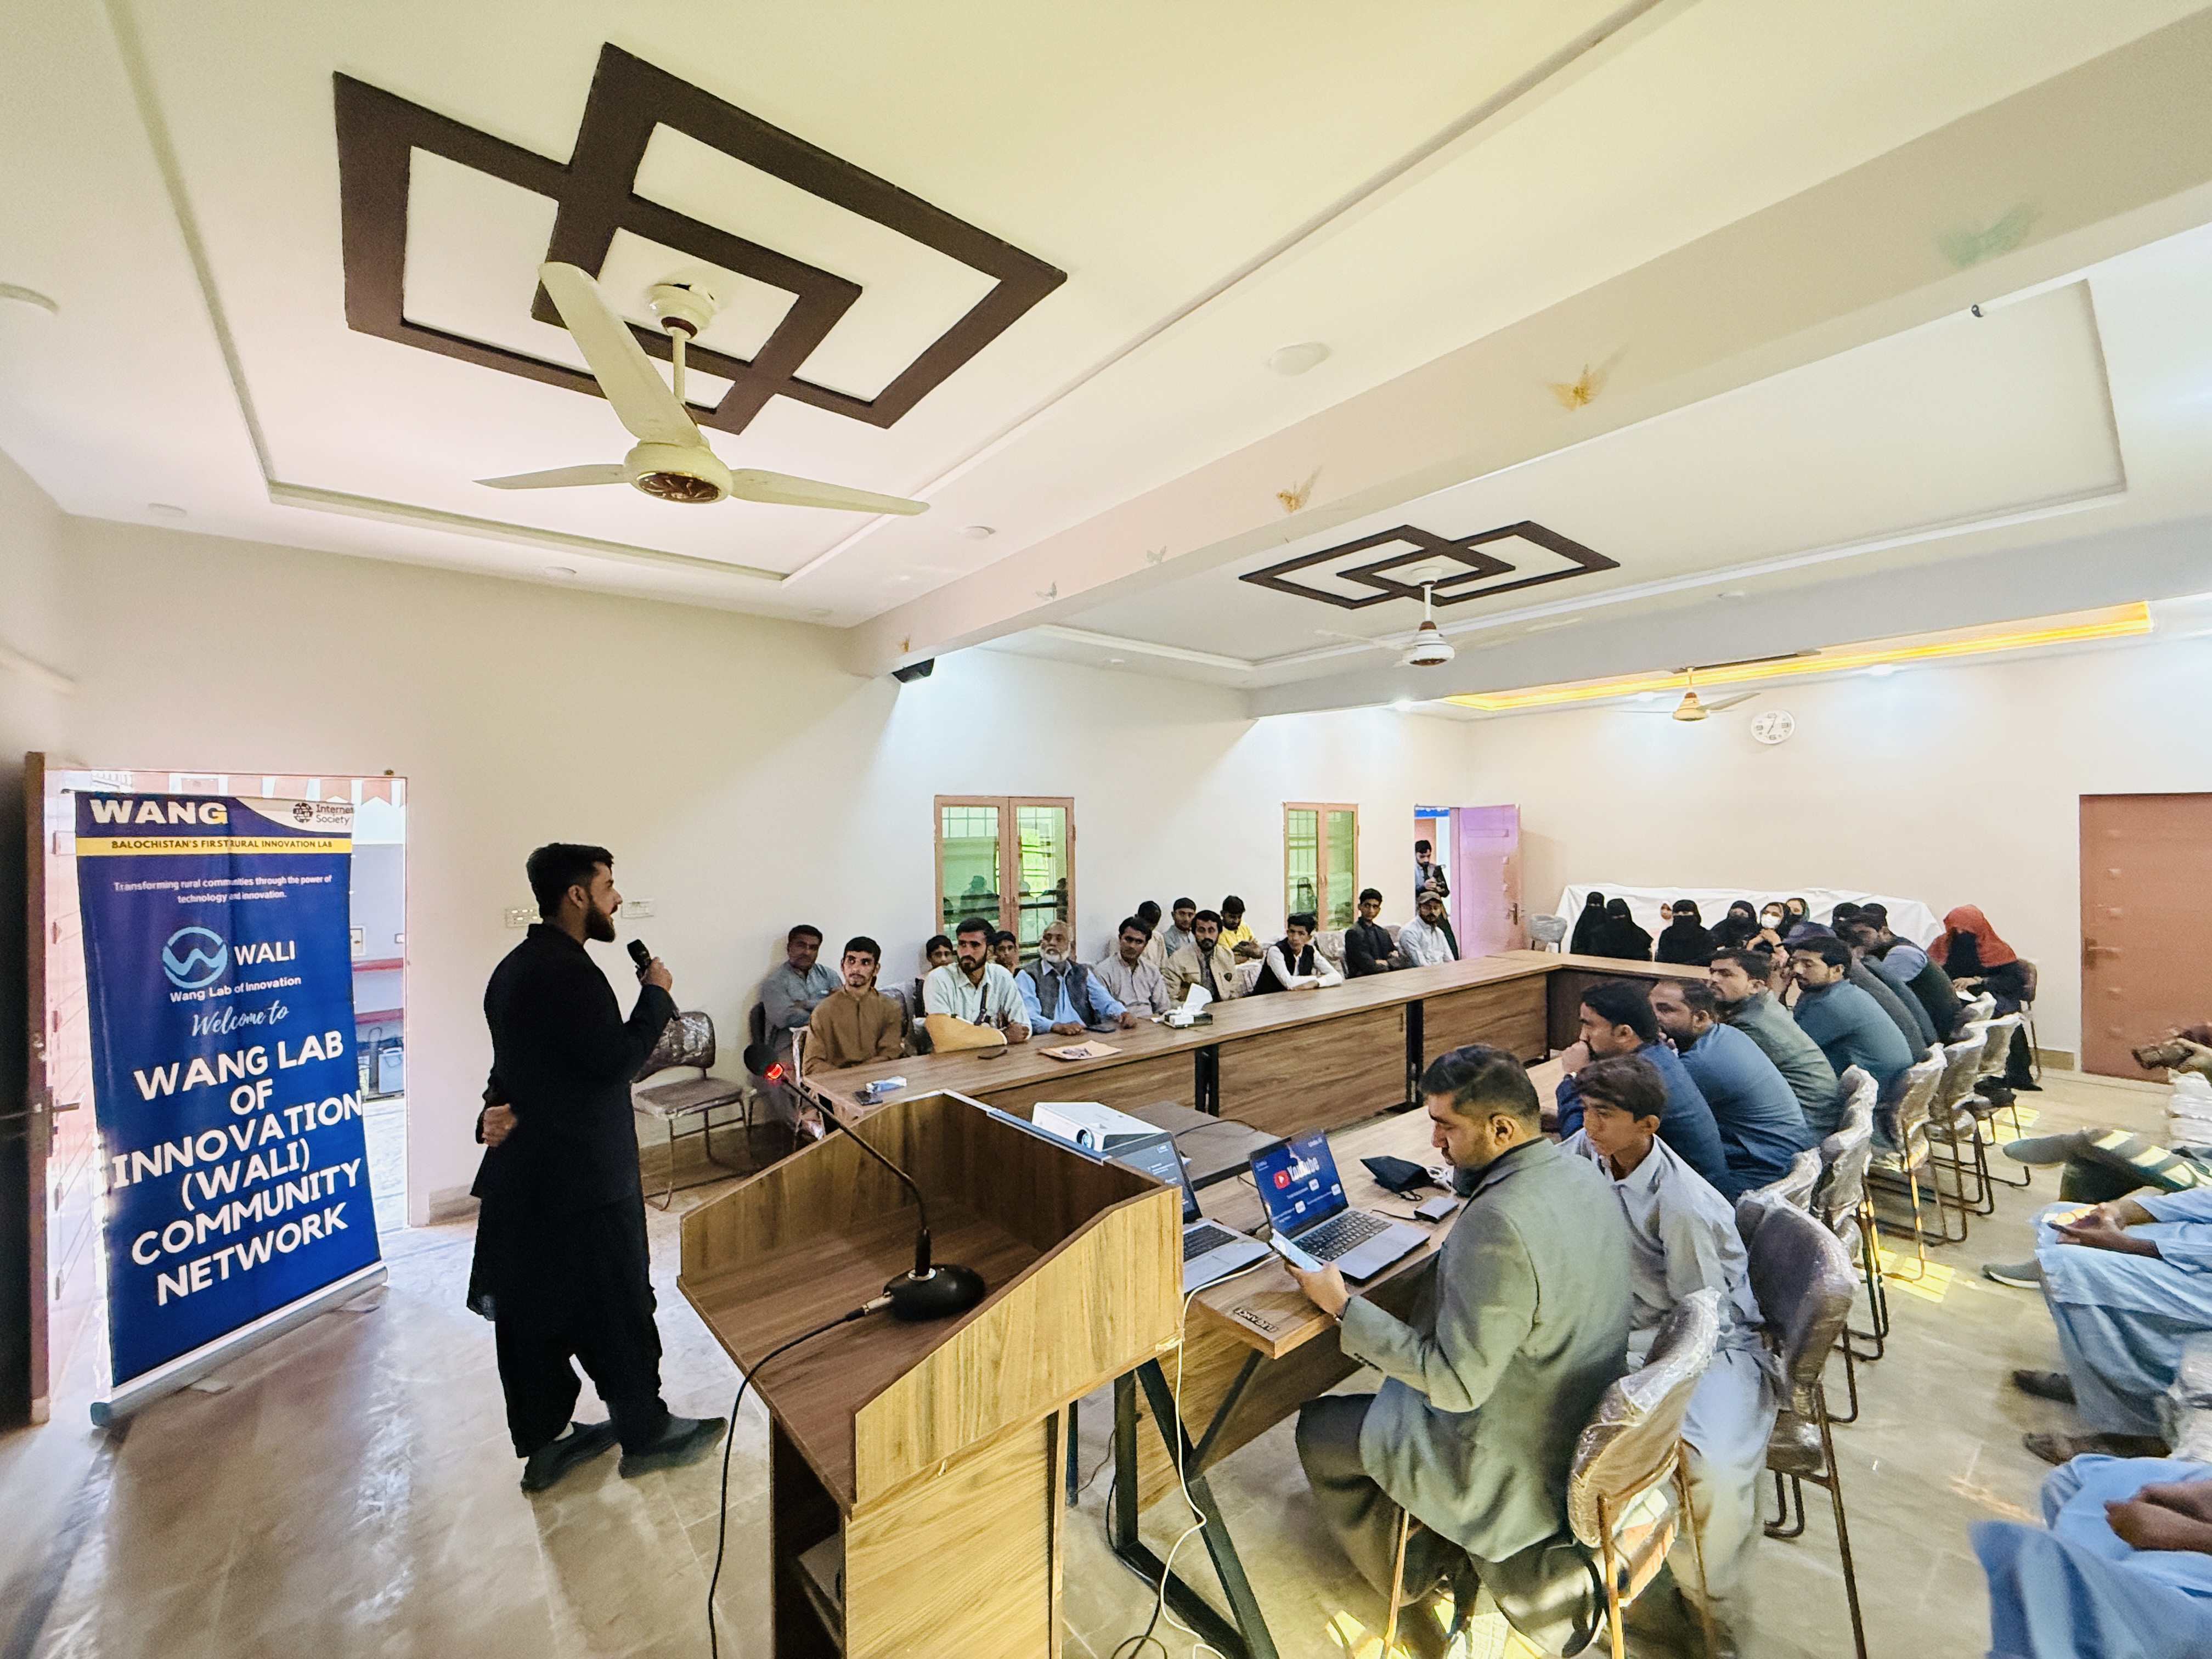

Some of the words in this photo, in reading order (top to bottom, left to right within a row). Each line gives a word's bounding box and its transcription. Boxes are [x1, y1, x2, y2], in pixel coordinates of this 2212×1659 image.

[89, 799, 228, 824] WANG
[316, 804, 354, 814] Internet
[316, 815, 350, 825] Society
[111, 840, 198, 849] BALOCHISTAN'S
[114, 881, 179, 891] Transforming
[180, 879, 201, 888] rural
[255, 876, 286, 886] through
[301, 877, 323, 885] power
[324, 874, 332, 883] of
[177, 893, 228, 904] technology
[242, 890, 287, 899] innovation.
[234, 940, 296, 966] WALI
[170, 990, 205, 1003] Wang
[208, 985, 232, 998] Lab
[234, 983, 245, 993] of
[245, 977, 302, 992] Innovation
[191, 1006, 266, 1037] Welcome
[267, 1000, 290, 1025] to
[133, 1046, 268, 1101] WANG
[278, 1030, 344, 1069] LAB
[230, 1078, 273, 1116] OF
[111, 1090, 363, 1189] INNOVATION
[182, 1138, 310, 1211] (WALI)
[132, 1158, 362, 1266] COMMUNITY
[157, 1202, 349, 1306] NETWORK
[1234, 1307, 1278, 1332] ELEGANCE
